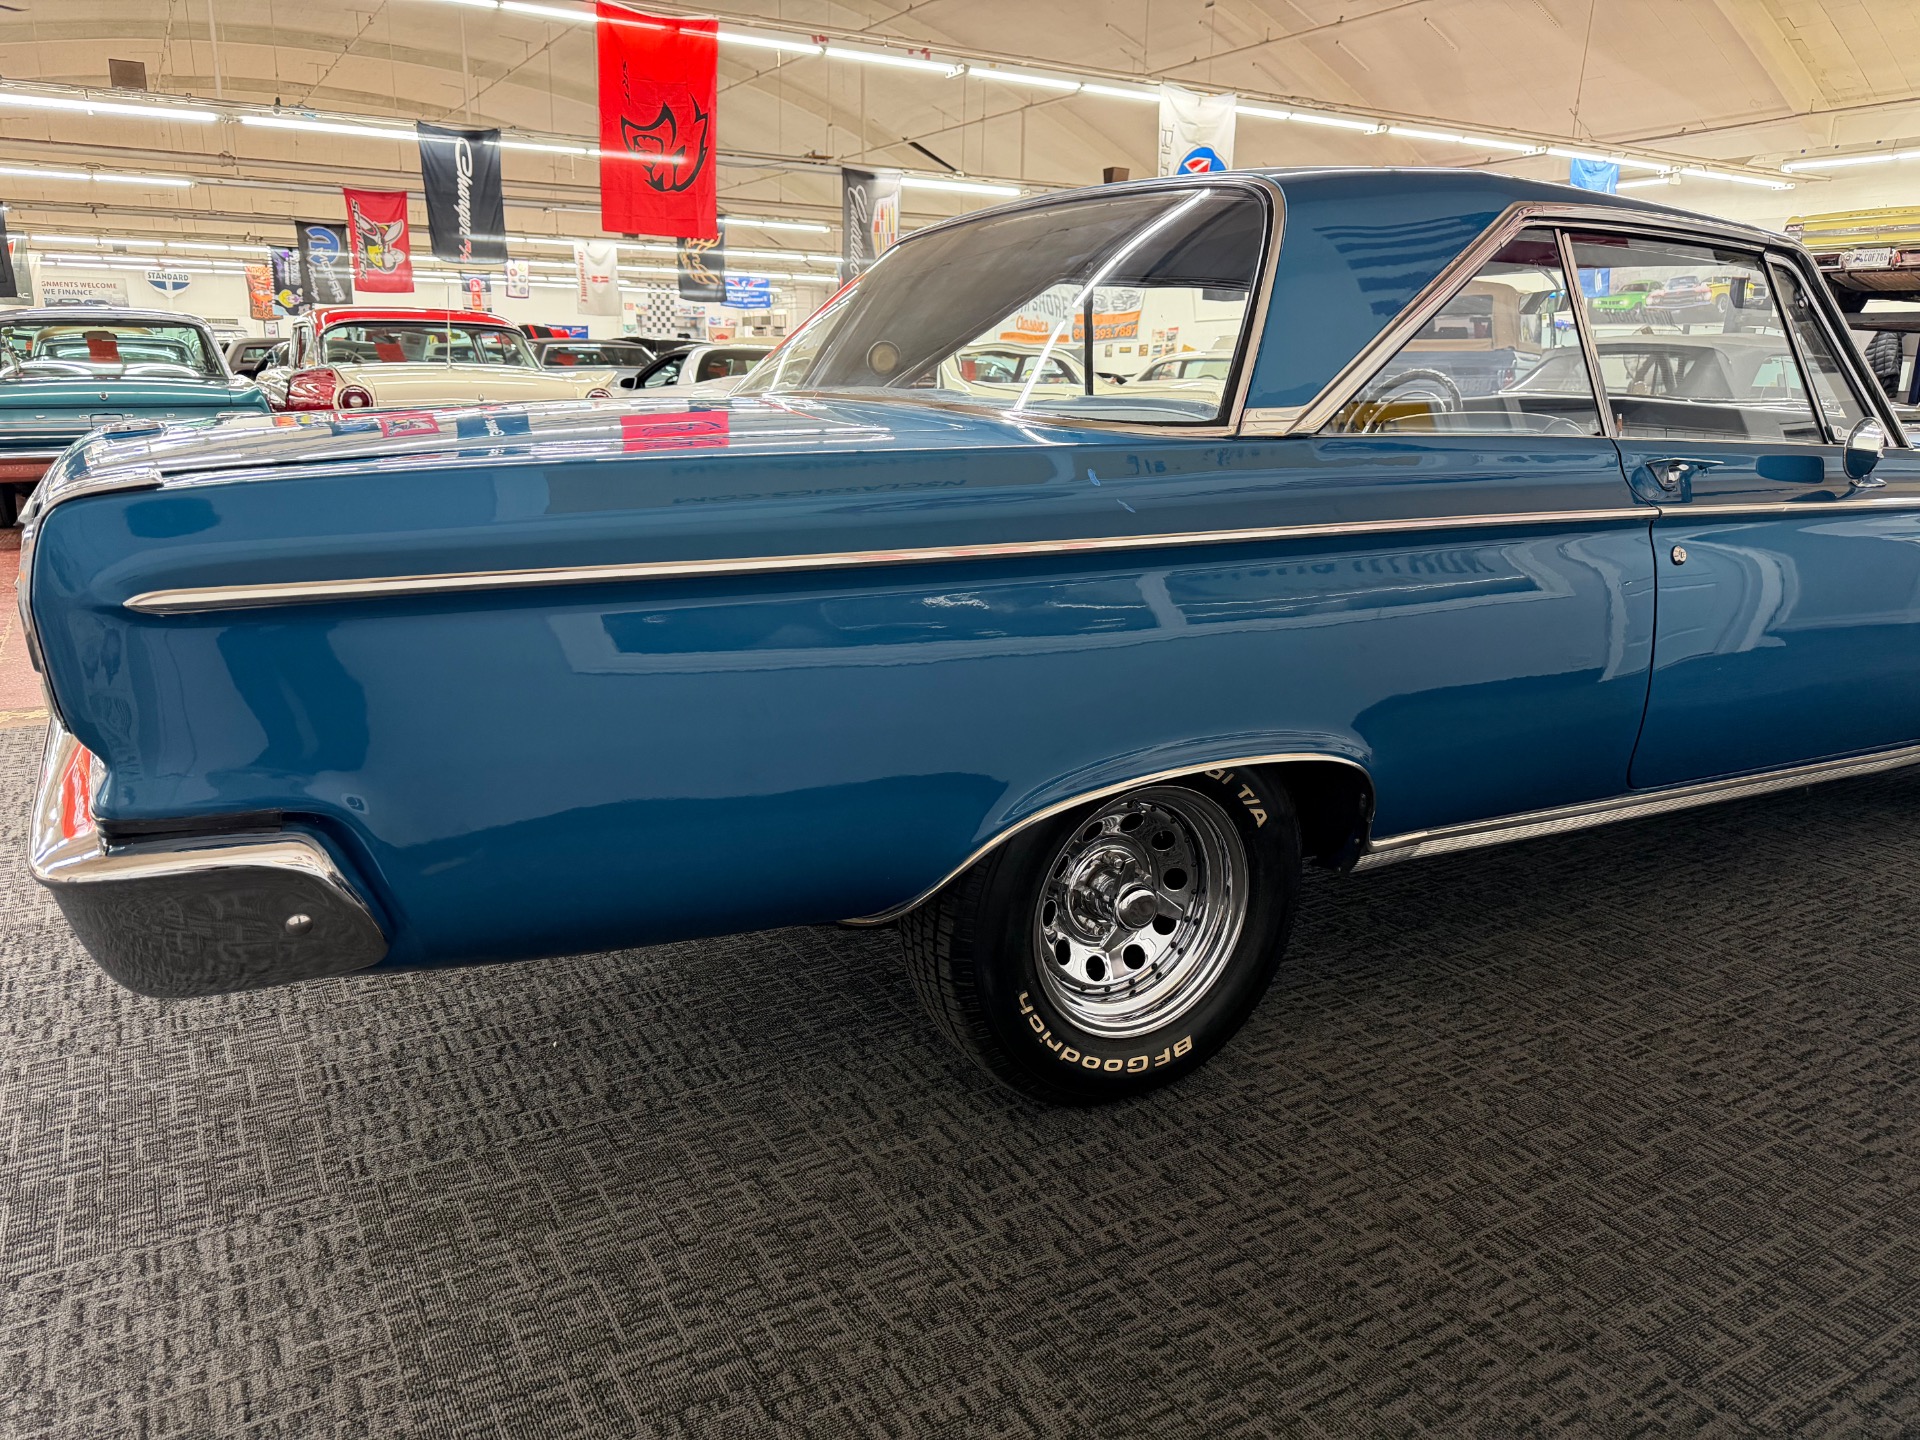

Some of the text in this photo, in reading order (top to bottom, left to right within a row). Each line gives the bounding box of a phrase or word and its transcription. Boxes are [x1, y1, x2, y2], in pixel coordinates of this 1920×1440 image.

[453, 136, 473, 236] Charger
[848, 185, 867, 275] Cadillac
[147, 271, 189, 281] STANDARD
[1016, 315, 1049, 332] Classics
[1237, 783, 1268, 829] T/A
[1018, 991, 1193, 1073] BFGoodrich
